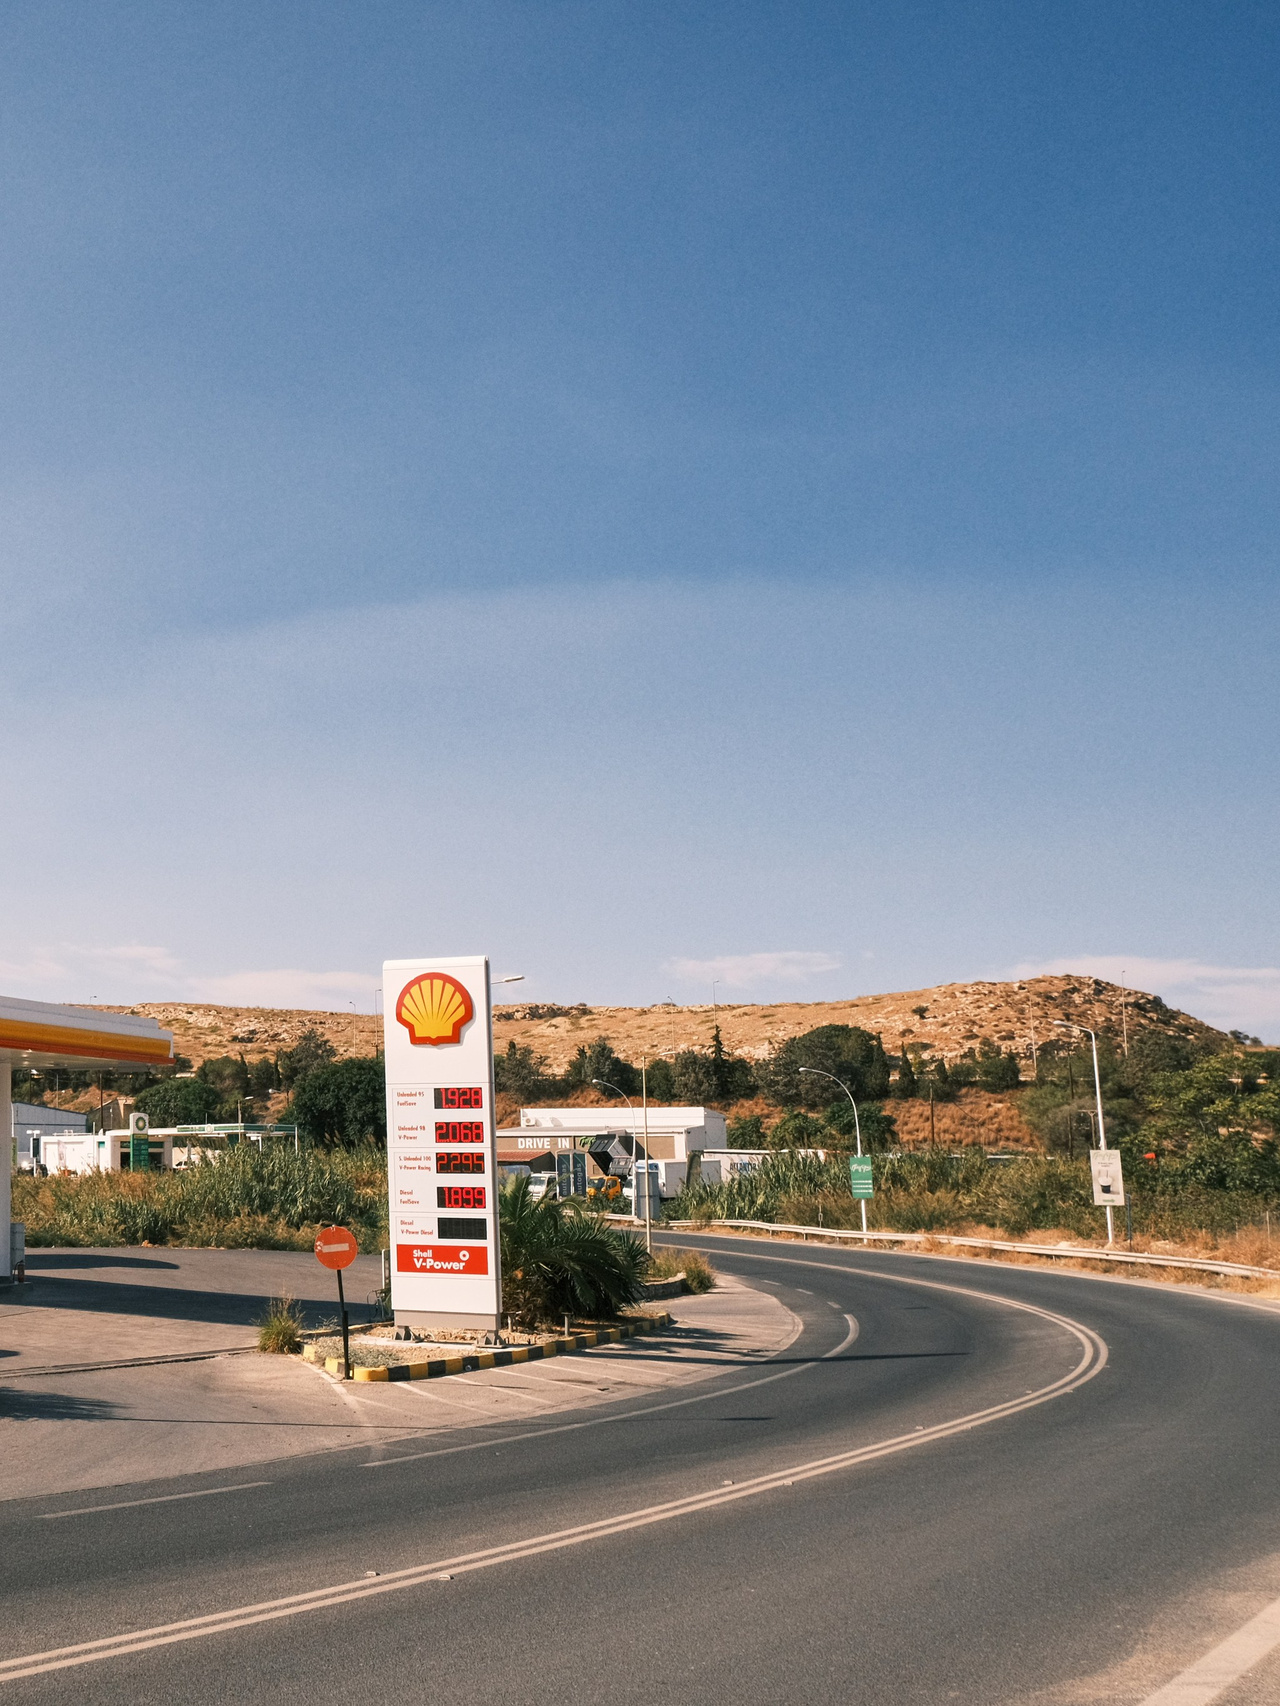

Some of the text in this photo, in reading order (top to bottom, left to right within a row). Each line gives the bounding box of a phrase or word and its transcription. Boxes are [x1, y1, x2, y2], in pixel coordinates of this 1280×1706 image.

[440, 1087, 482, 1109] 1.928
[435, 1122, 484, 1143] 2.068
[517, 1137, 570, 1149] DRIVE IN
[437, 1153, 484, 1173] 2.295
[443, 1187, 486, 1209] 1.899
[413, 1249, 433, 1258] Shell
[413, 1258, 465, 1270] V-Power
